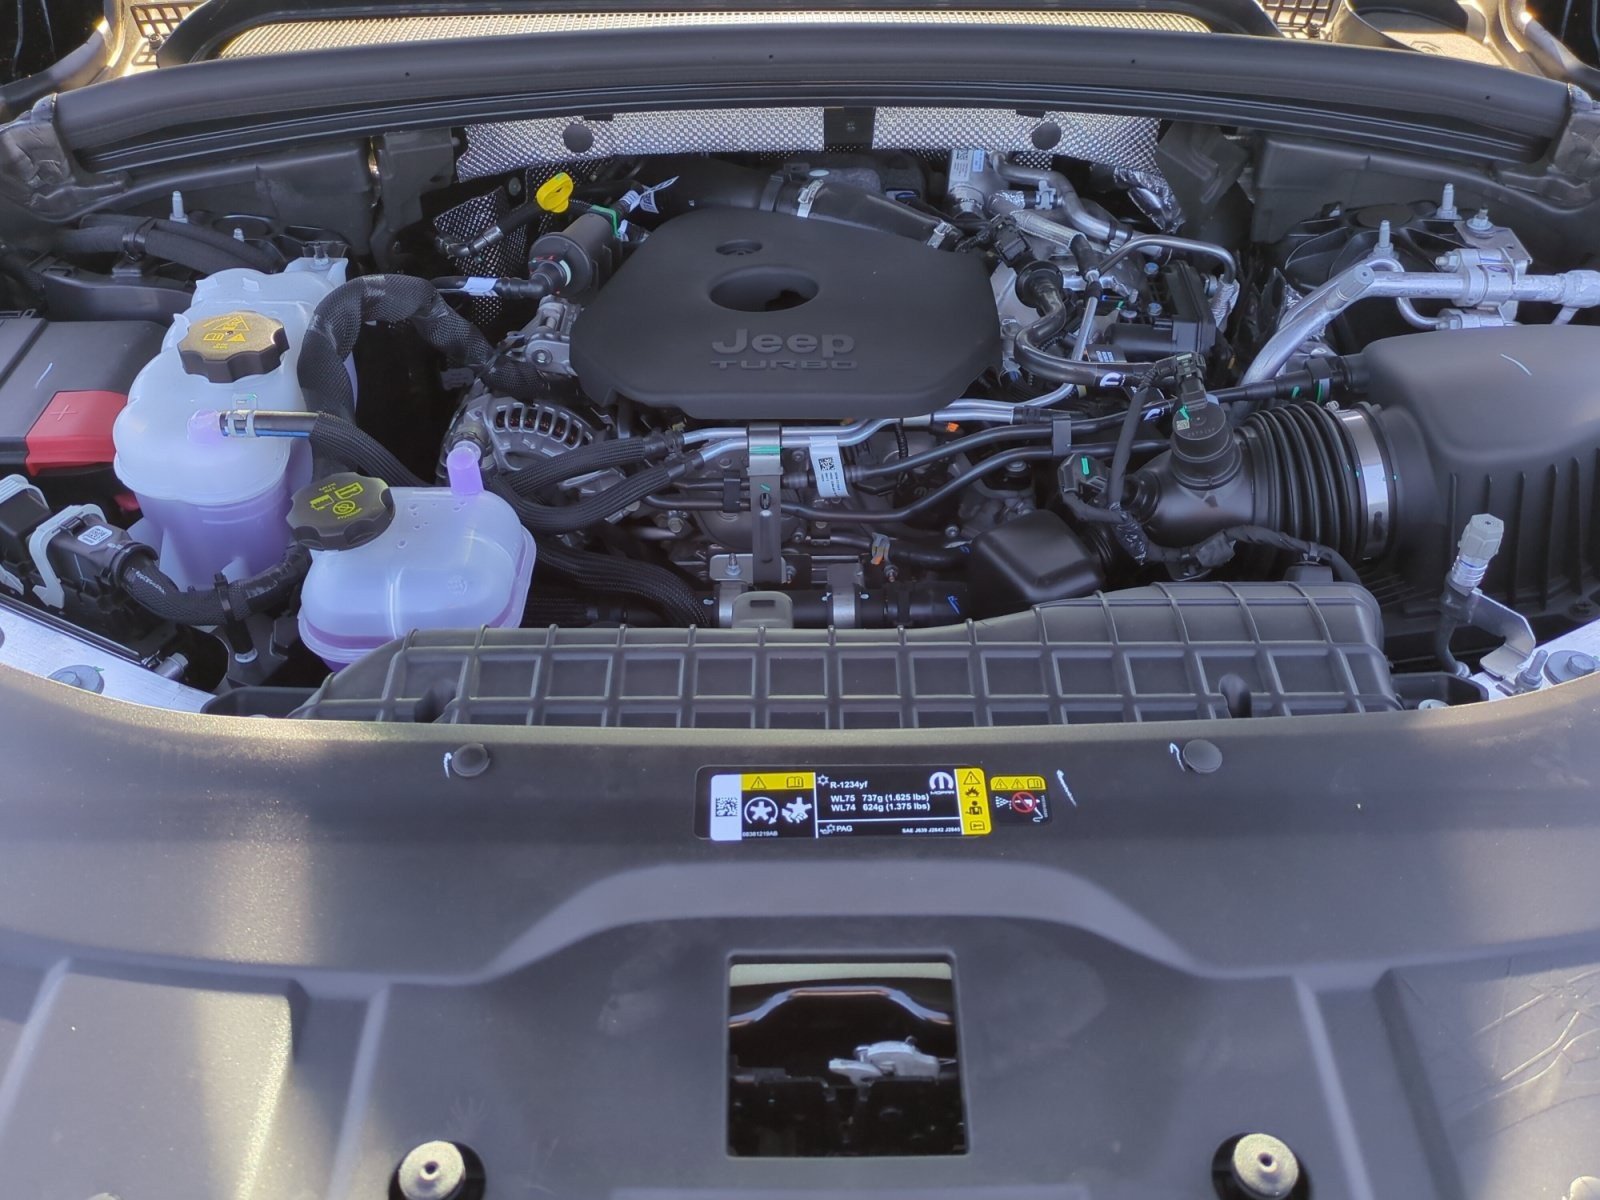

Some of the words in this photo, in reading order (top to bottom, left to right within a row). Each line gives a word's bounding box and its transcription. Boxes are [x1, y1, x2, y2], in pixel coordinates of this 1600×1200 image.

[711, 328, 855, 358] Jeep
[710, 360, 858, 370] TURBO
[830, 781, 868, 790] R-1234yf
[830, 794, 856, 803] WL75
[861, 794, 883, 803] 737g
[885, 793, 911, 802] (1.625
[912, 793, 930, 802] lbs)
[831, 803, 856, 812] WL74
[862, 803, 884, 812] 624g
[885, 803, 912, 812] (1.375
[913, 802, 931, 811] lbs)
[836, 825, 853, 833] PAG
